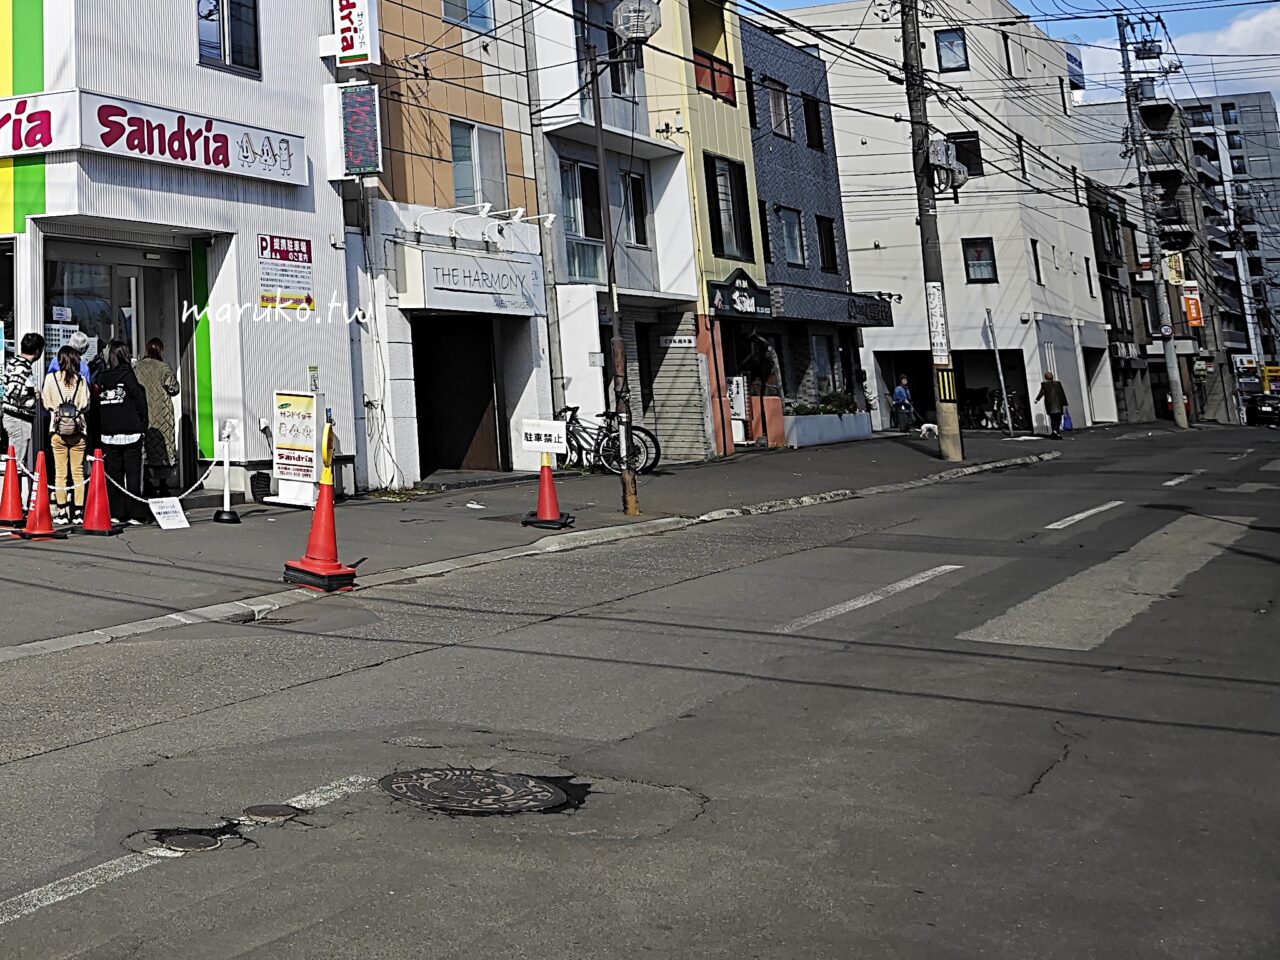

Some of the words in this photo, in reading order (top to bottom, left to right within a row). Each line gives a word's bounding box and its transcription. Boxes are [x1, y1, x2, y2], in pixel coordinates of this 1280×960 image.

[97, 104, 231, 168] Sandria
[260, 236, 268, 256] P
[433, 267, 459, 285] THE
[463, 269, 526, 297] HARMONY
[524, 432, 563, 443] 駐車禁止
[277, 453, 313, 463] Sandria
